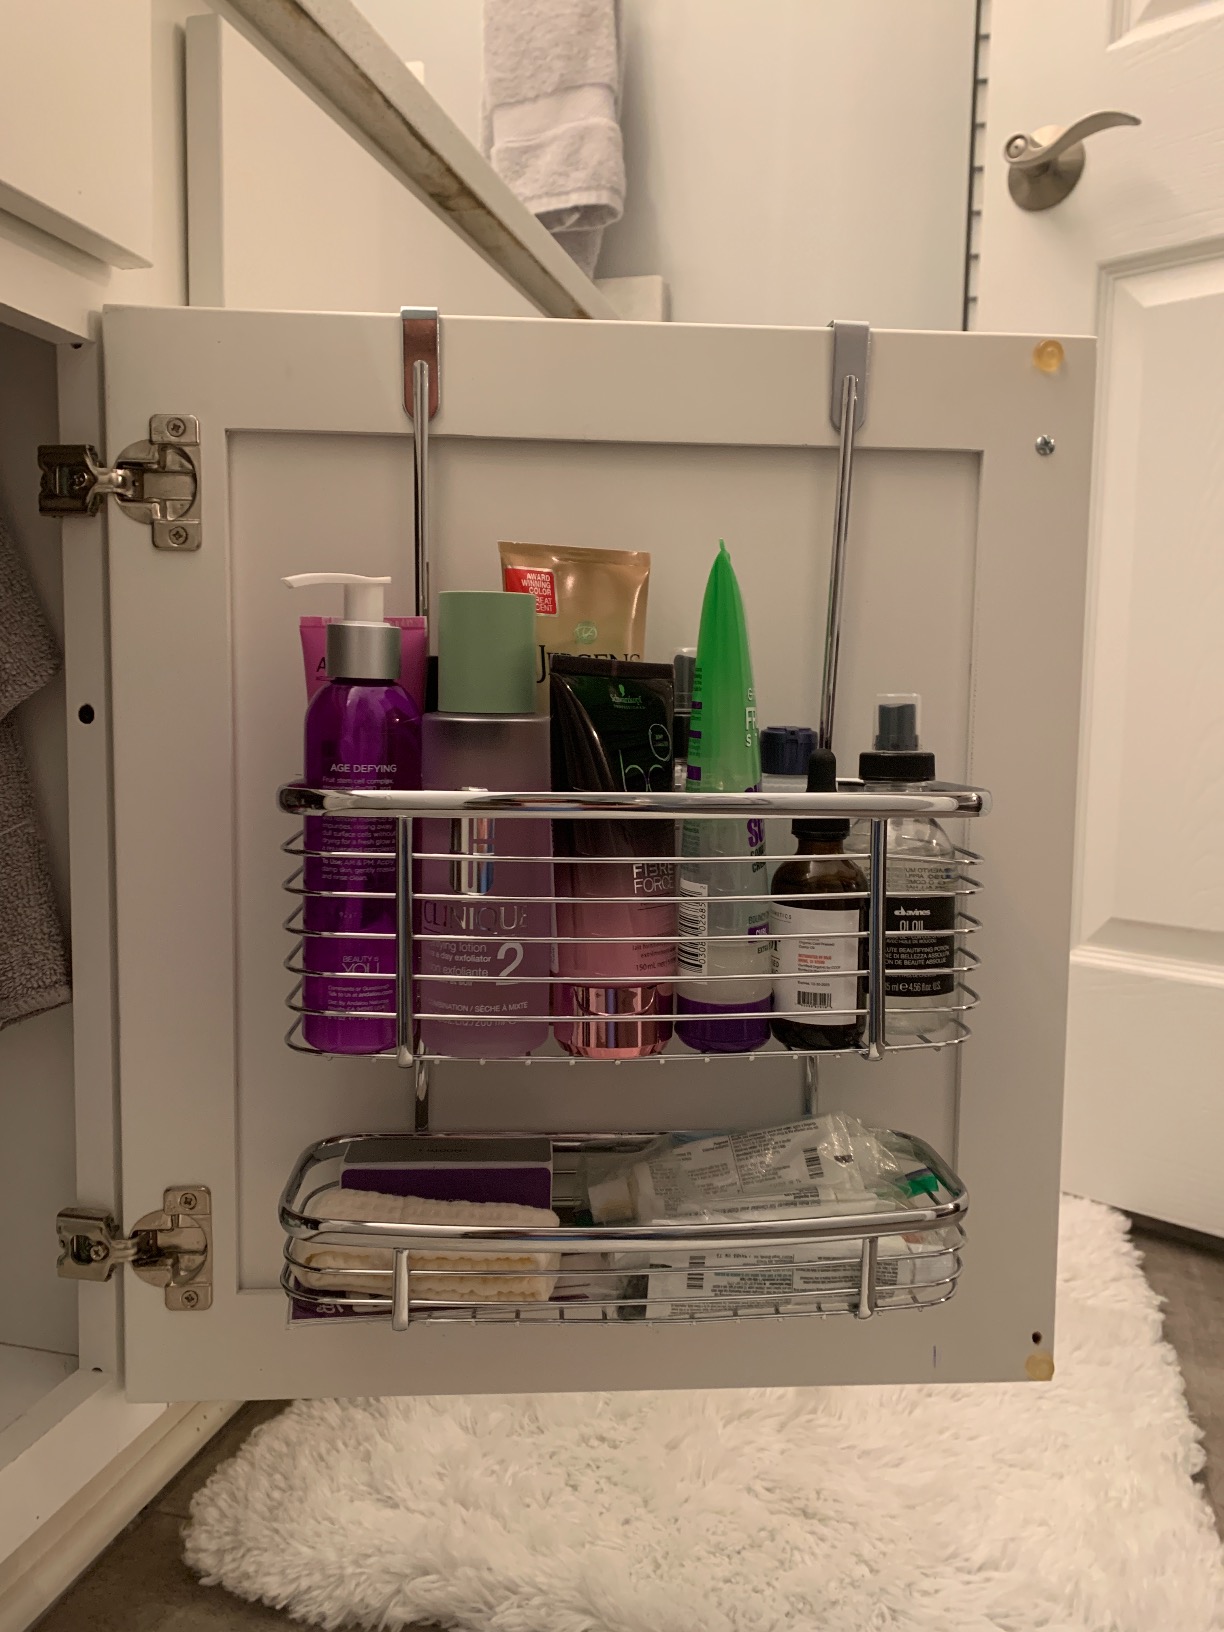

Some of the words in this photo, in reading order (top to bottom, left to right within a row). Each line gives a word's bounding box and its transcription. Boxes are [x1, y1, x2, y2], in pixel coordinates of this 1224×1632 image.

[526, 573, 550, 582] AWARD
[521, 580, 552, 588] WINNING
[528, 587, 552, 596] COLOR
[536, 604, 553, 612] CENT
[330, 764, 351, 772] AGE
[353, 764, 398, 772] DEFYING
[632, 863, 674, 879] FIBRE
[634, 875, 674, 894] FORCE
[894, 906, 931, 916] davines
[424, 900, 528, 935] CLINIQUE
[458, 942, 487, 953] lotion
[454, 954, 492, 962] exfoliator
[342, 962, 380, 974] YOU
[496, 942, 524, 986] 2
[442, 963, 488, 976] exfoliante
[508, 1002, 529, 1011] MIXTE
